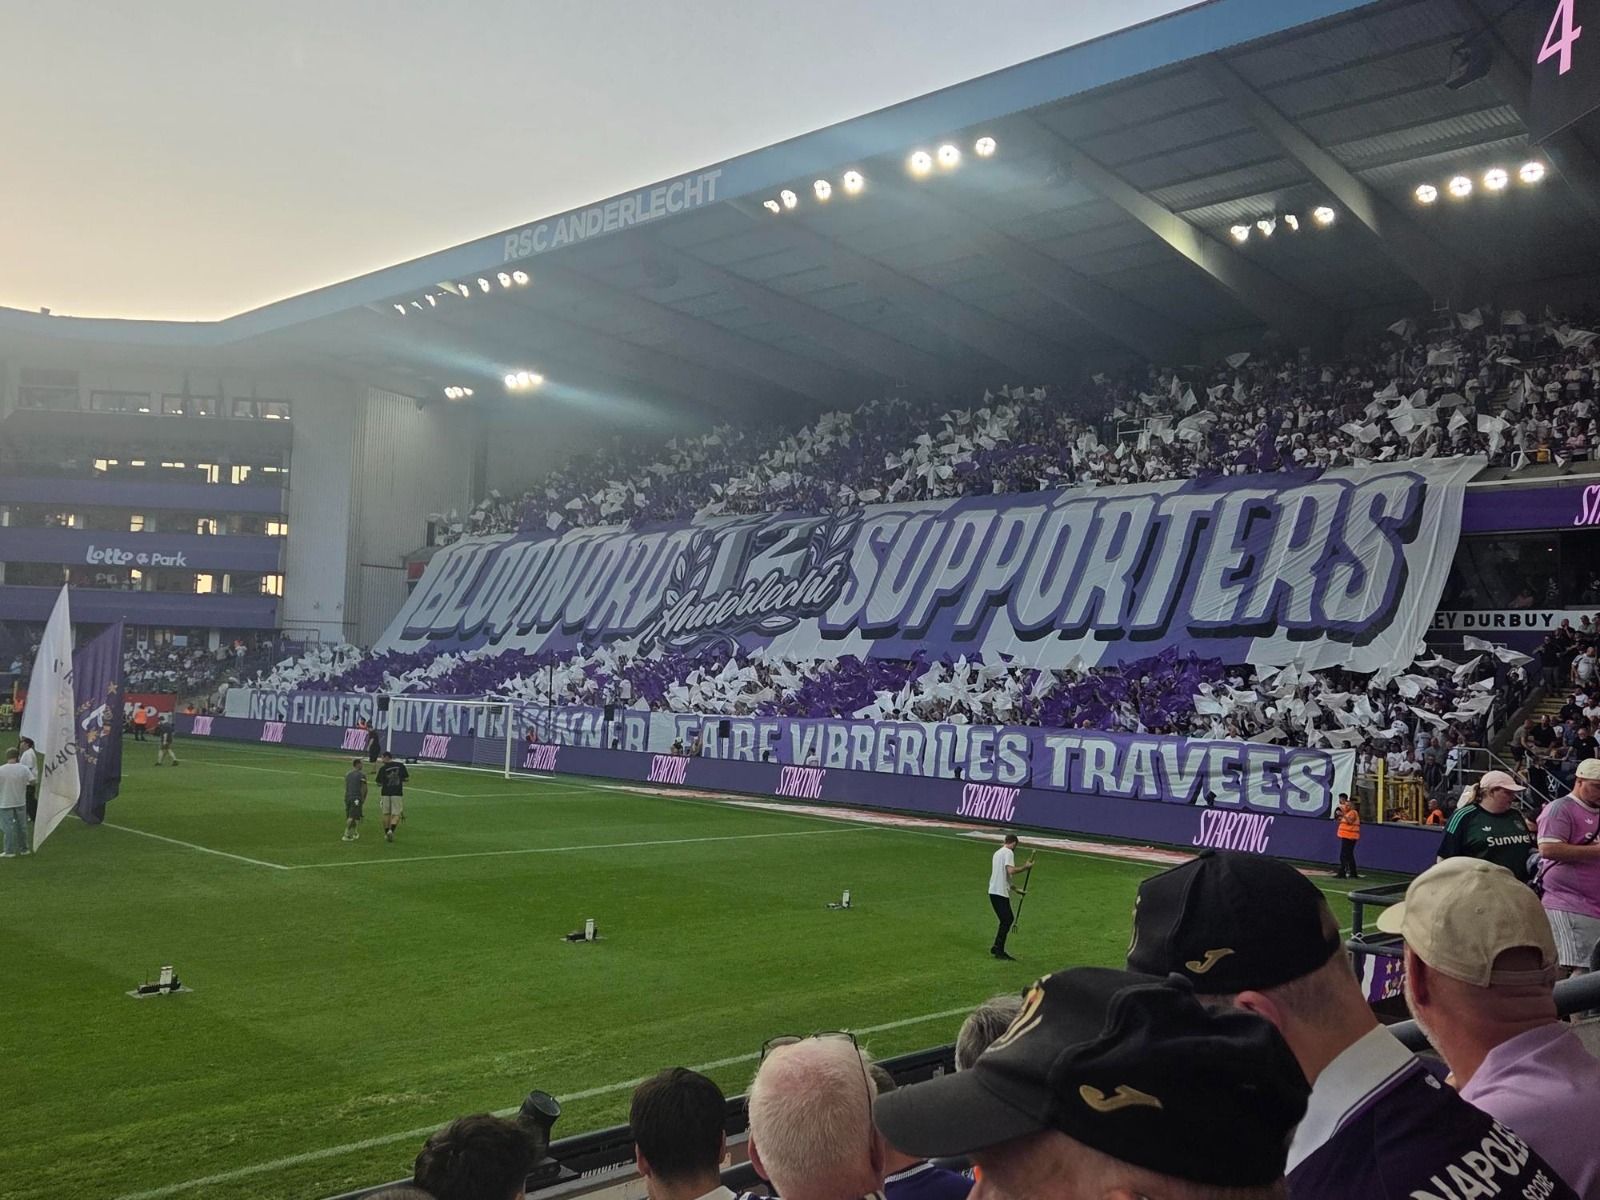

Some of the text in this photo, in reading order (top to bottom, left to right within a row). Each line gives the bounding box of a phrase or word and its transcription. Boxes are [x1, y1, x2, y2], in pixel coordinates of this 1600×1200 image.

[1537, 0, 1582, 76] 4
[504, 168, 722, 262] RSC ANDERLECHT
[86, 545, 187, 567] Lotto Park
[820, 472, 1428, 642] SUPPORTERS
[643, 564, 843, 644] Anderlecht
[1463, 613, 1553, 627] DURBUY
[249, 692, 289, 722] NOS
[292, 693, 372, 728] CHANTS
[647, 755, 690, 785] STARTING
[775, 765, 826, 799] STARTING
[788, 721, 924, 776] VIBRER
[938, 729, 1029, 784] LES
[1043, 735, 1334, 815] TRAVEES
[956, 782, 1021, 822] STARTING
[1192, 808, 1275, 854] STARTING
